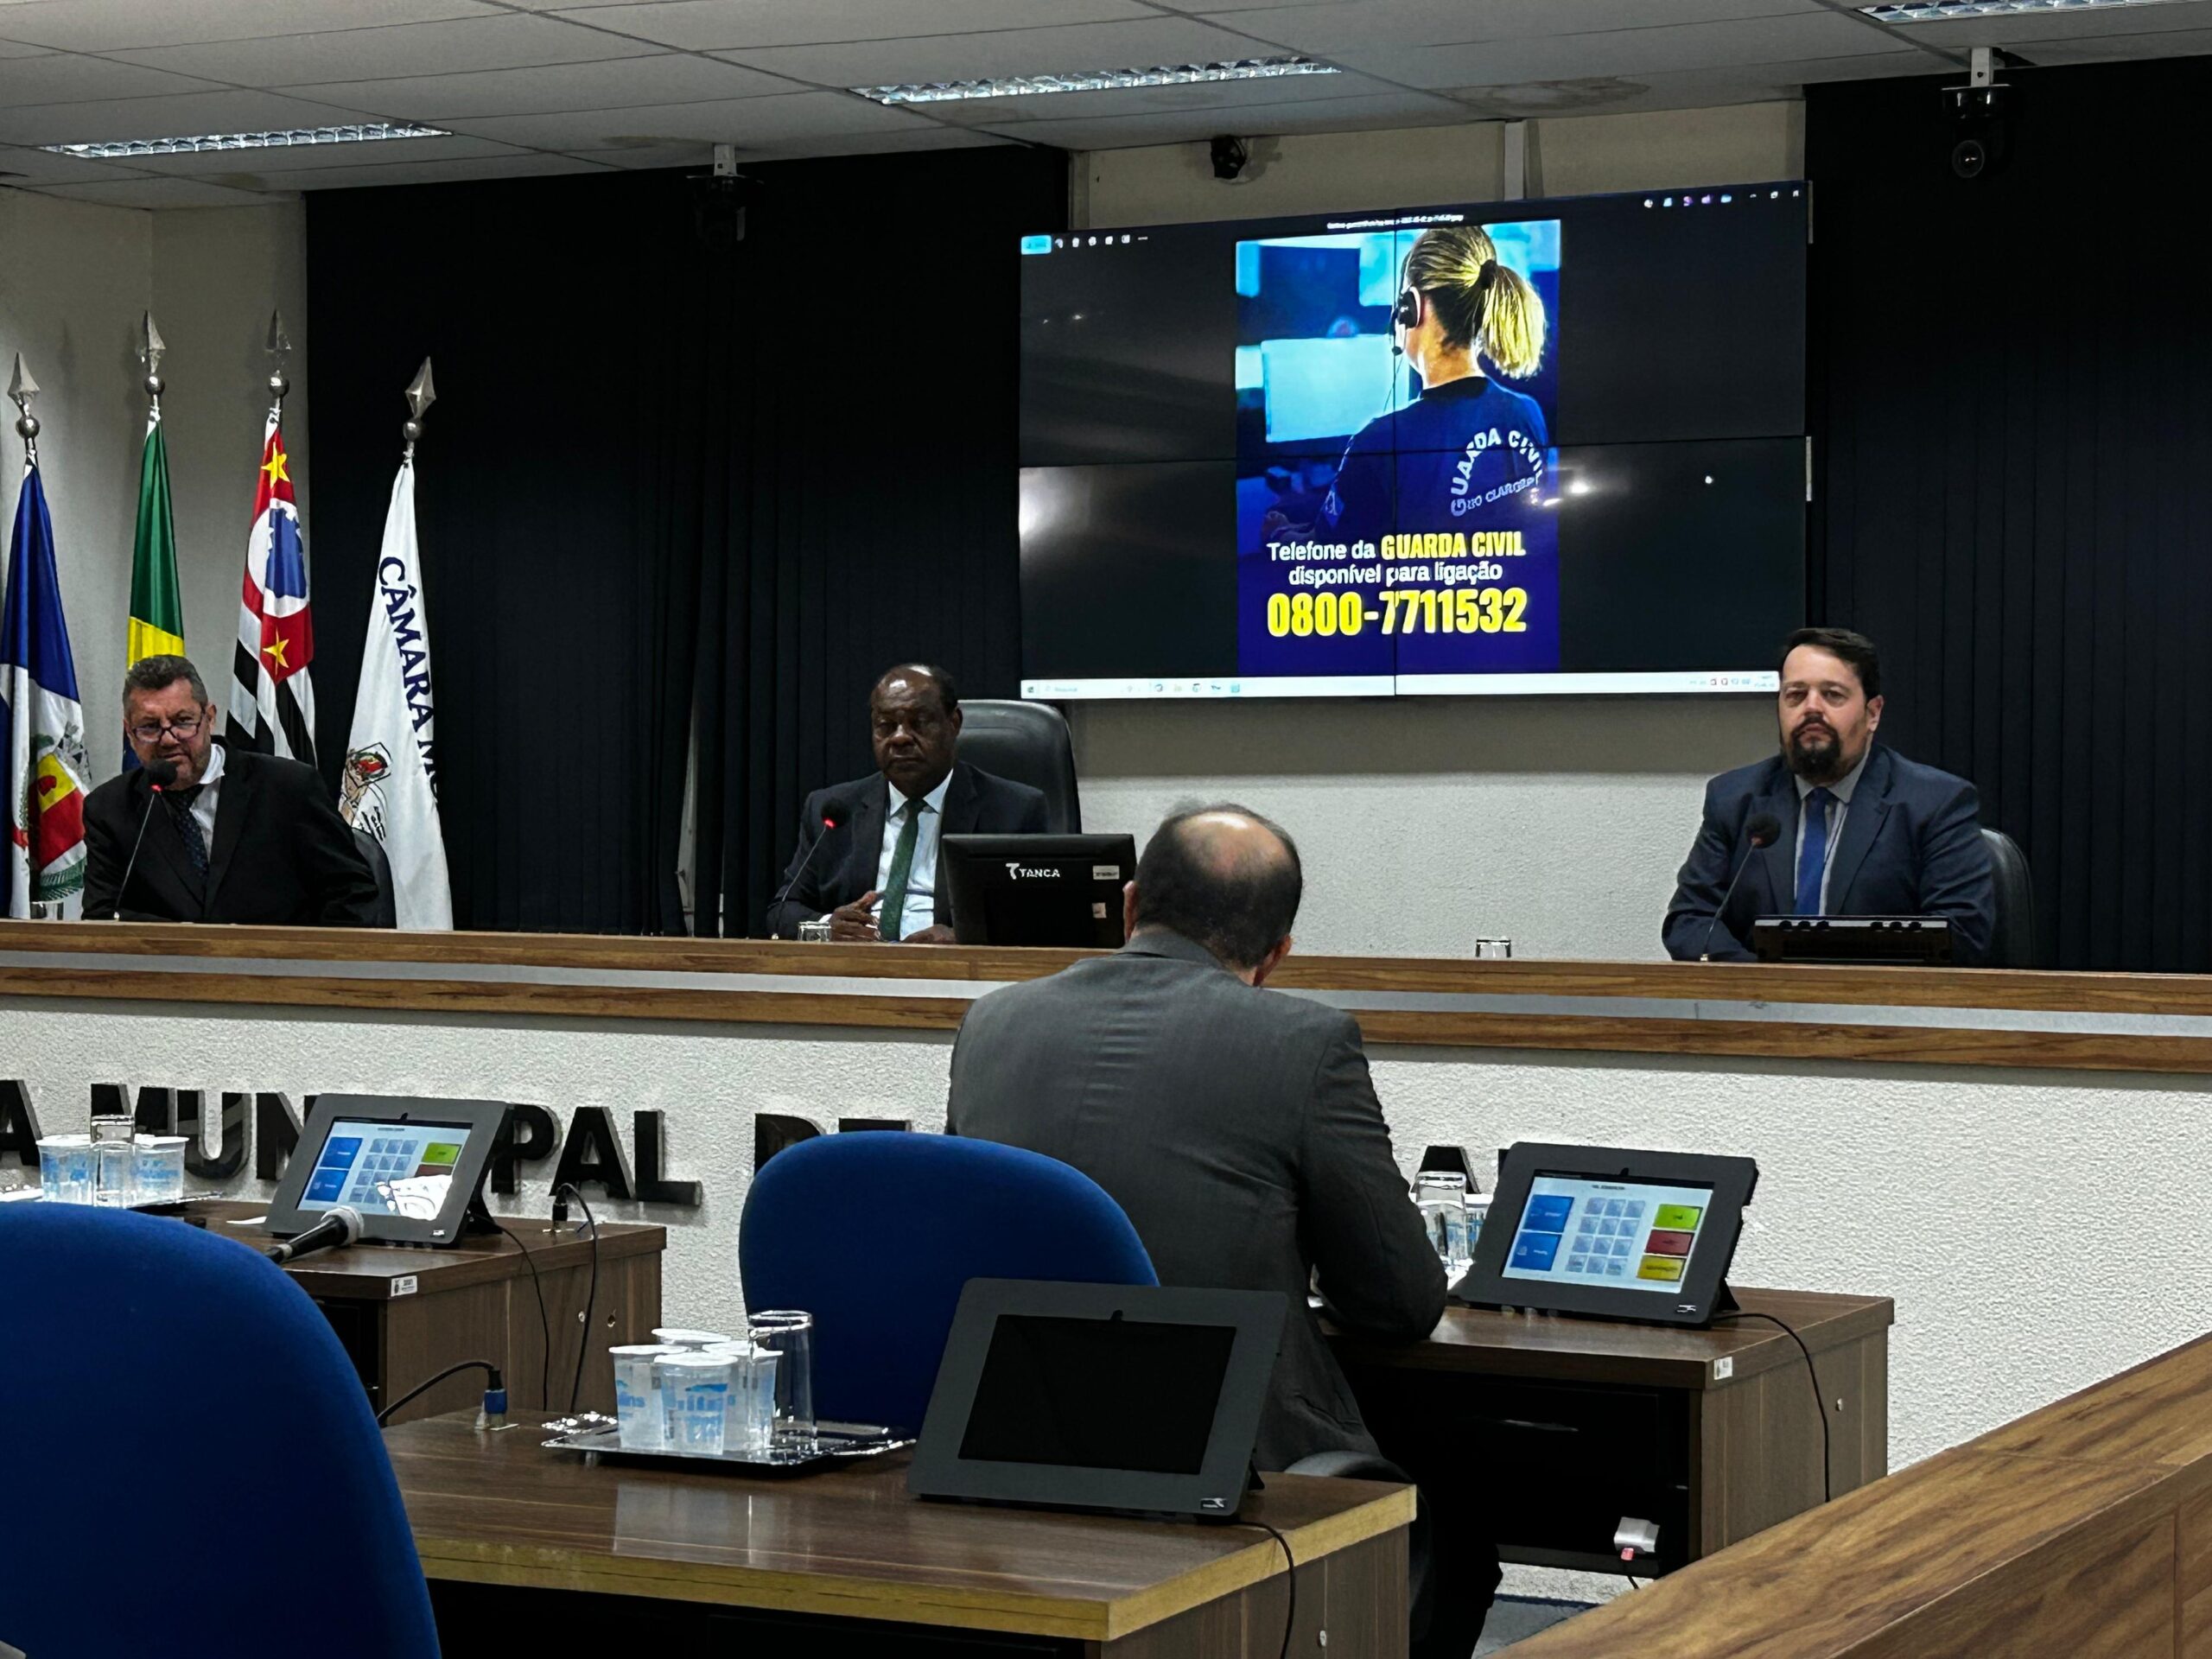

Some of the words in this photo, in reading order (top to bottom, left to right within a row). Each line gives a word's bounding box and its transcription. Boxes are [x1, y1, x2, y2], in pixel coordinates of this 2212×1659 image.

[1451, 428, 1502, 517] GUARDA
[1266, 540, 1348, 562] Telefone
[1351, 539, 1376, 559] da
[1381, 533, 1467, 560] GUARDA
[1471, 531, 1527, 557] CIVIL
[1288, 563, 1382, 588] disponível
[1386, 566, 1431, 588] para
[1434, 561, 1503, 585] ligação
[1268, 587, 1528, 637] 0800-7711532
[378, 556, 434, 733] CÂMARA
[1019, 868, 1061, 878] TANCA
